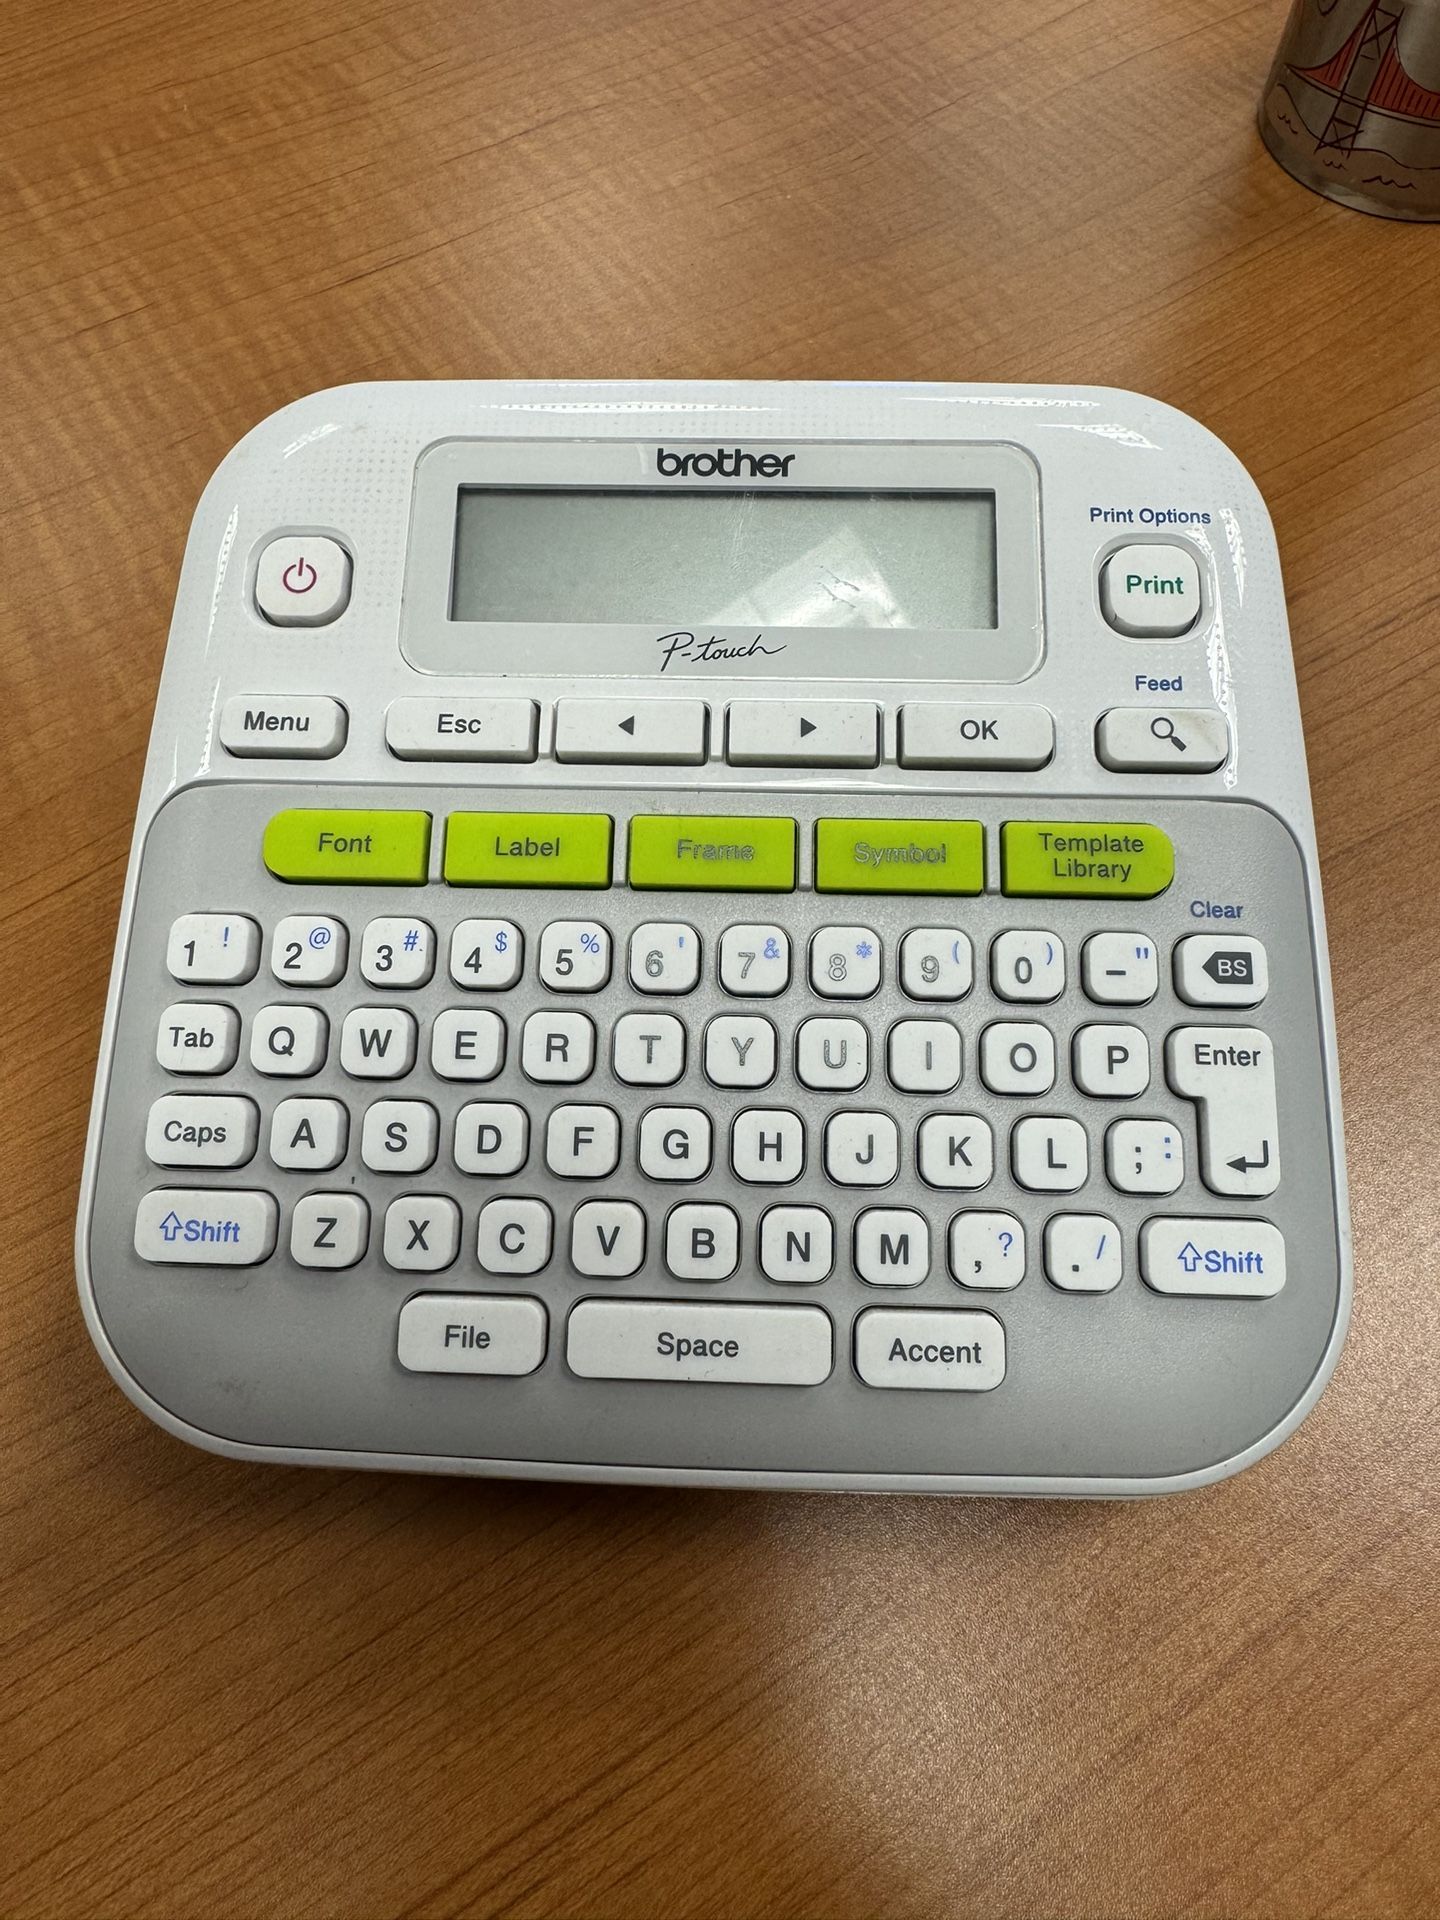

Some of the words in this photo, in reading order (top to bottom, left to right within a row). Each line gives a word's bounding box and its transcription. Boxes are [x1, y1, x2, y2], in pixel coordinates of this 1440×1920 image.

[656, 447, 796, 478] brother
[1090, 507, 1134, 523] Print
[1138, 508, 1211, 527] Options
[1126, 574, 1184, 595] Print
[656, 631, 787, 672] P-touch
[1135, 675, 1183, 692] Feed
[243, 710, 310, 732] Menu
[437, 713, 482, 734] Esc
[960, 719, 999, 741] OK
[318, 832, 373, 853] Font
[495, 836, 560, 857] Label
[677, 838, 754, 861] Frame
[853, 841, 947, 868] Symbol
[1037, 832, 1145, 858] Template
[1052, 858, 1133, 884] Library
[1190, 900, 1244, 919] Clear
[183, 940, 196, 967] 1
[283, 942, 303, 970] 2
[375, 944, 393, 972] 3
[463, 946, 483, 974] 4
[555, 948, 574, 976] 5
[645, 949, 664, 978] 6
[737, 951, 756, 980] 7
[828, 953, 848, 982] 8
[1217, 959, 1248, 977] BS
[920, 955, 940, 984] 9
[1014, 956, 1033, 985] 0
[169, 1026, 214, 1048] Tab
[268, 1025, 295, 1057] Q
[359, 1028, 393, 1058] W
[454, 1030, 478, 1060] E
[545, 1033, 570, 1063] R
[639, 1034, 662, 1065] T
[730, 1036, 755, 1067] Y
[823, 1039, 848, 1070] U
[925, 1040, 933, 1071] I
[1009, 1042, 1038, 1073] O
[1107, 1045, 1130, 1075] P
[1194, 1043, 1262, 1067] Enter
[163, 1120, 227, 1148] Caps
[289, 1118, 316, 1149] A
[384, 1121, 408, 1153] S
[476, 1124, 502, 1155] D
[573, 1126, 595, 1157] F
[662, 1128, 689, 1160] G
[758, 1131, 783, 1162] H
[855, 1134, 874, 1165] J
[948, 1136, 973, 1167] K
[1046, 1137, 1068, 1169] L
[183, 1219, 241, 1244] Shift
[313, 1217, 338, 1249] Z
[406, 1219, 430, 1251] X
[499, 1222, 526, 1255] C
[596, 1225, 621, 1257] V
[691, 1227, 716, 1259] B
[786, 1231, 811, 1263] N
[880, 1233, 909, 1266] M
[1203, 1249, 1265, 1275] Shift
[444, 1324, 491, 1350] File
[656, 1331, 739, 1362] Space
[888, 1337, 982, 1364] Accent
